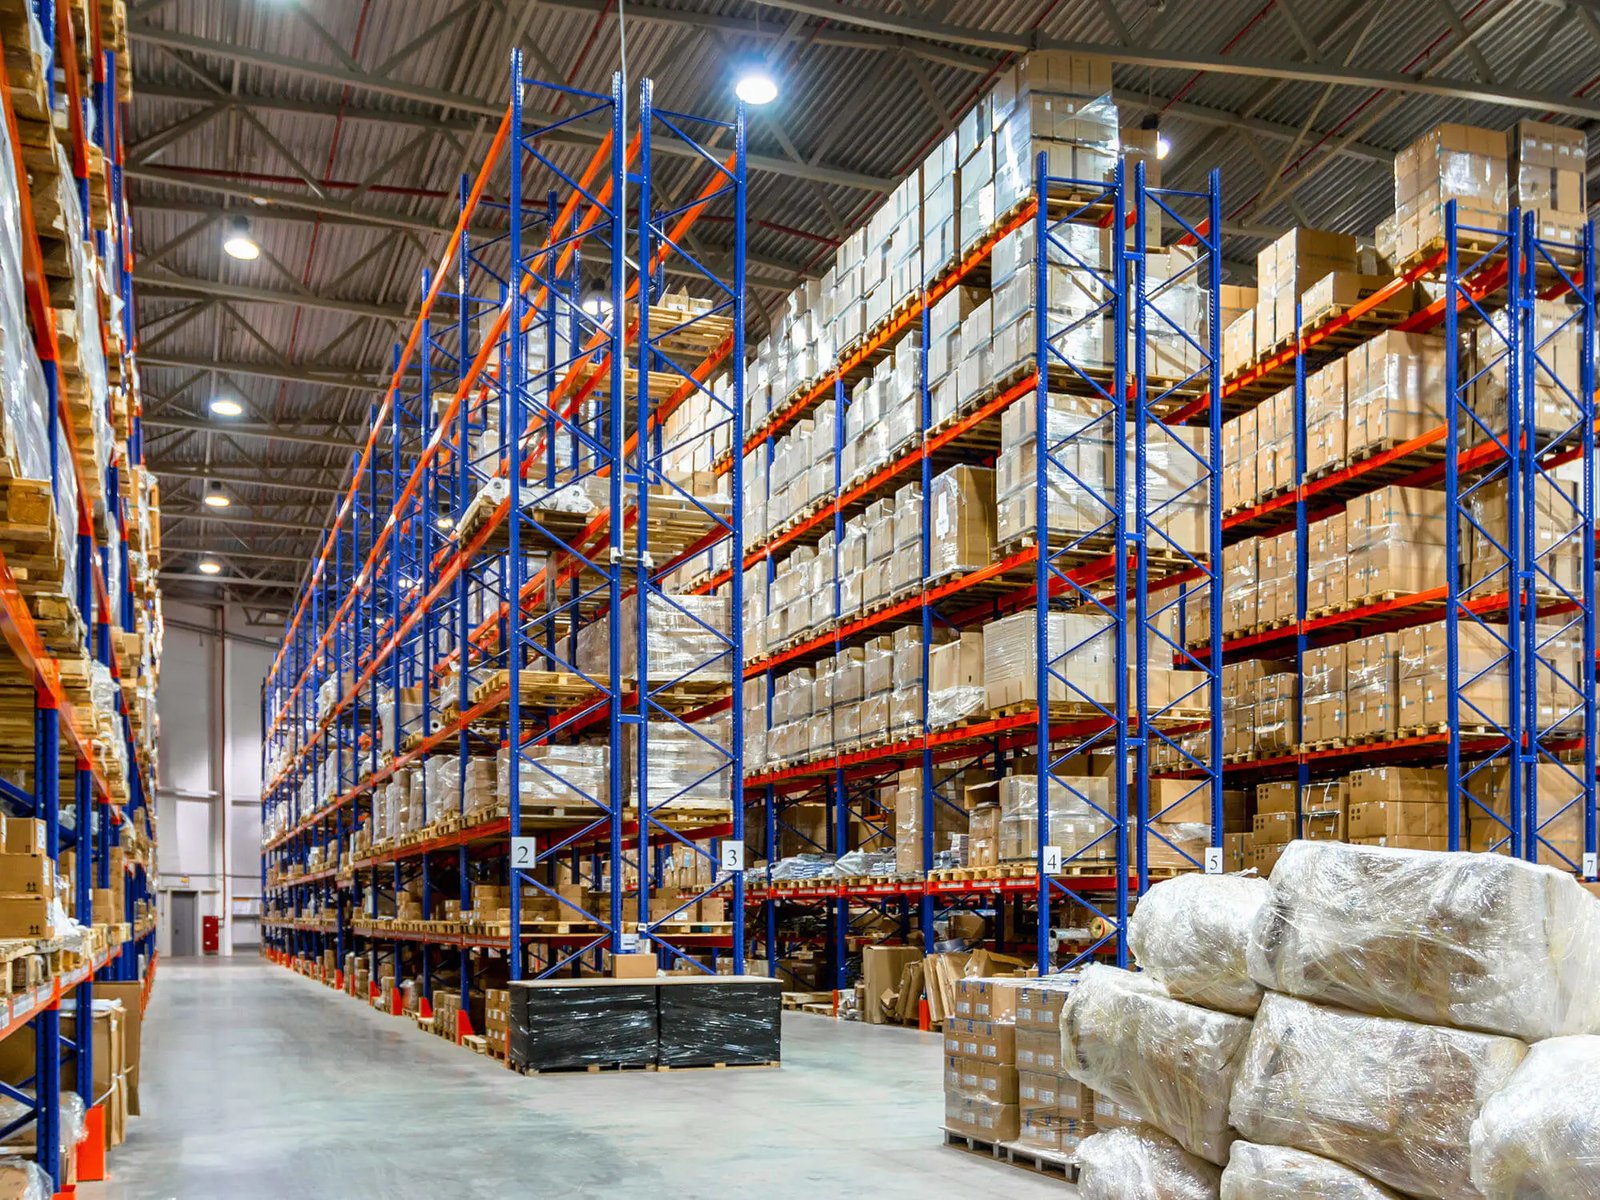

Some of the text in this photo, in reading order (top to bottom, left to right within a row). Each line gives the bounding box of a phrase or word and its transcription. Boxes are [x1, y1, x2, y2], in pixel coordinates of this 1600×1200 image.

[516, 845, 529, 864] 2
[727, 849, 738, 867] 3
[1047, 854, 1057, 870] 4
[1209, 855, 1218, 871] 5
[1587, 860, 1594, 873] 7
